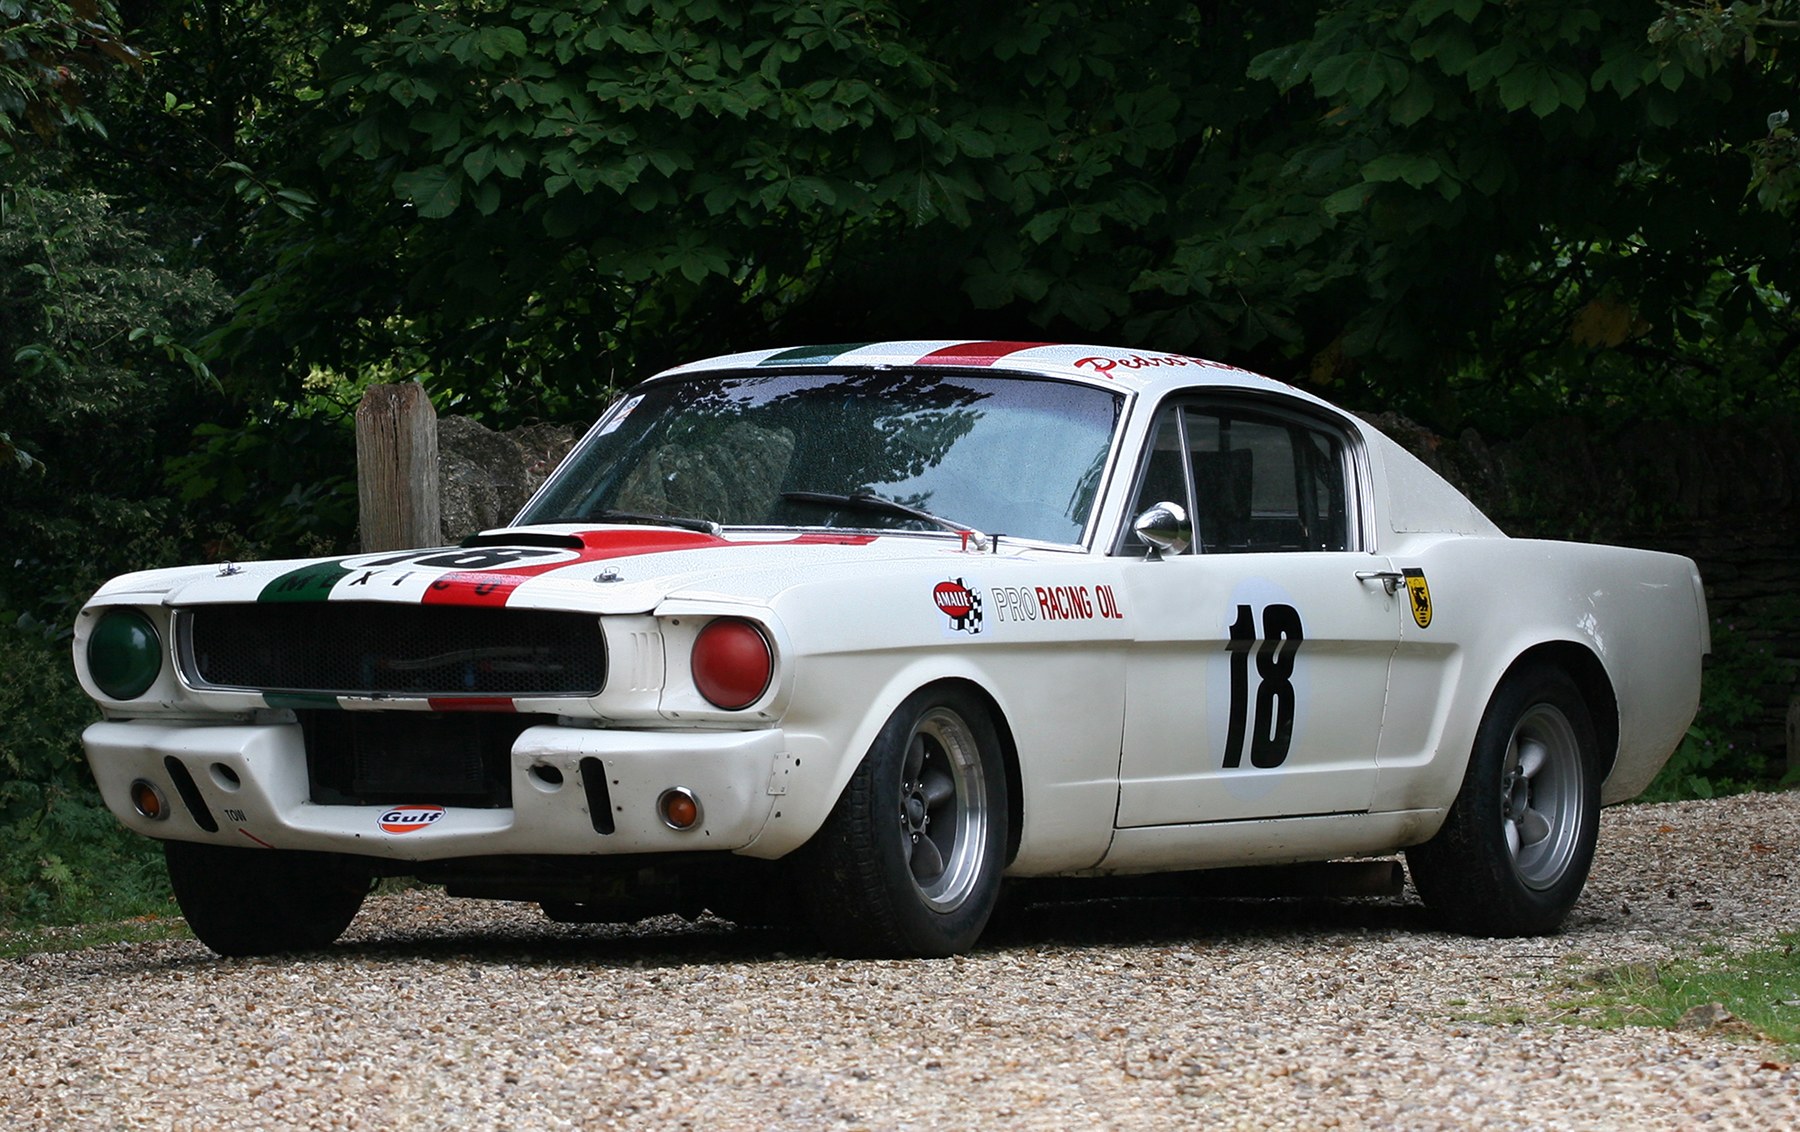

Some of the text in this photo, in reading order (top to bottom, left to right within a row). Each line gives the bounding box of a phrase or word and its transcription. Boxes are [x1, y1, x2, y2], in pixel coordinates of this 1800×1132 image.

[275, 569, 500, 596] MEXICO
[936, 591, 970, 607] AMALIE
[1095, 585, 1124, 619] OIL
[1221, 603, 1304, 769] 18
[224, 809, 247, 823] TOW
[381, 808, 444, 824] Gulf
